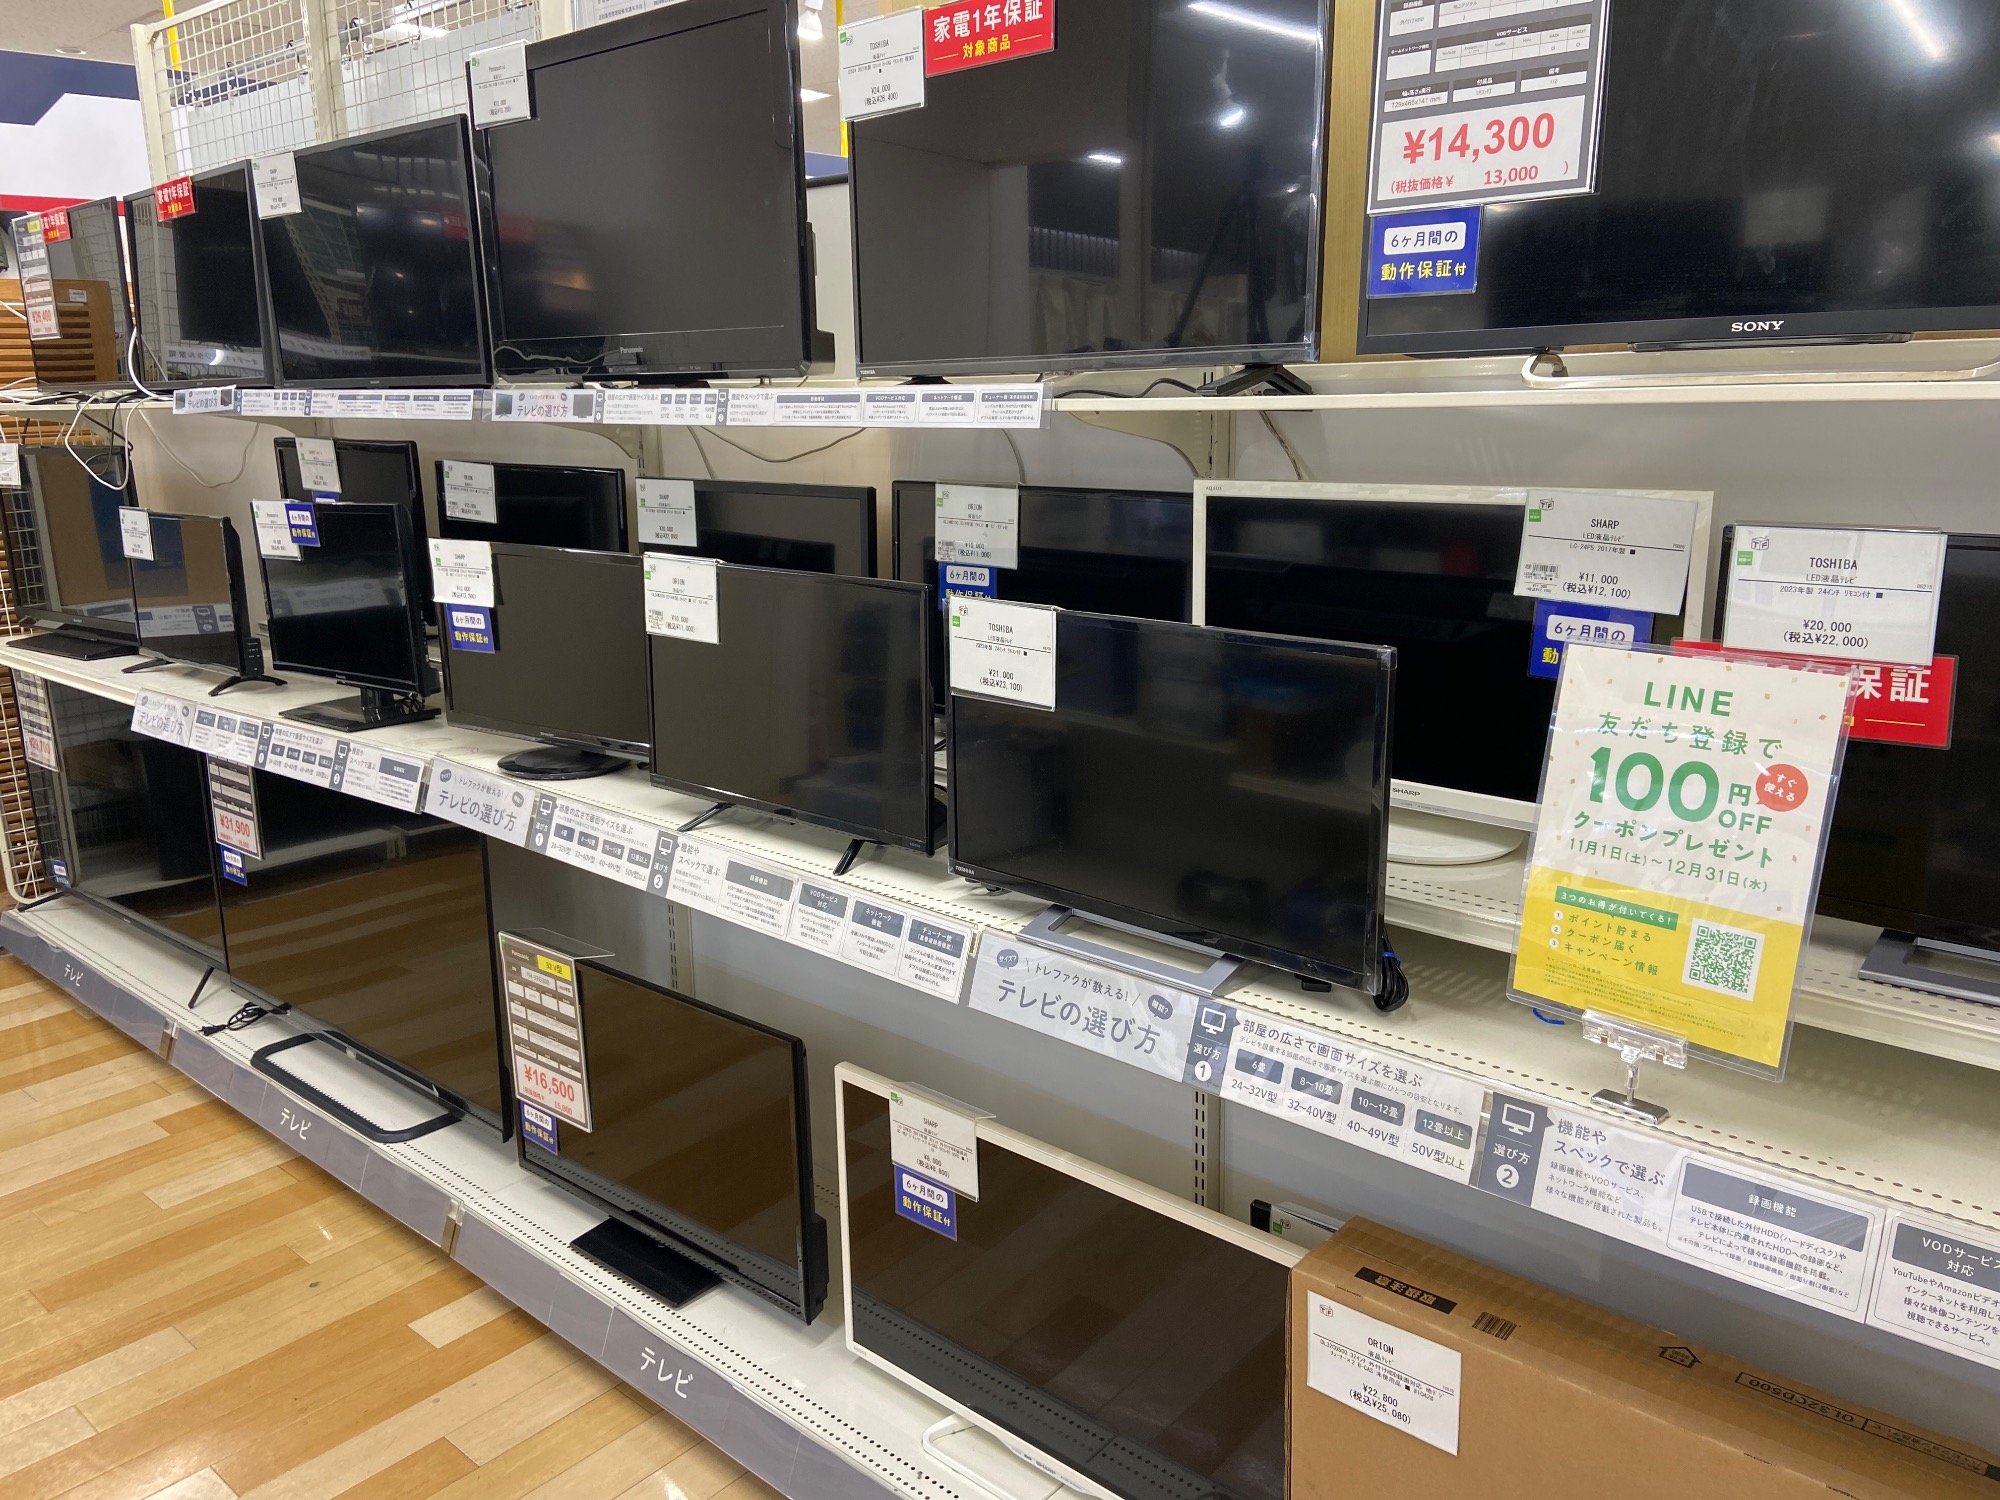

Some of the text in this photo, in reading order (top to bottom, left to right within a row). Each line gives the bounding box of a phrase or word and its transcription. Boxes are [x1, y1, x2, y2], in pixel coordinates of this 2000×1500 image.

[933, 0, 1043, 43] 家電1年保証
[1496, 26, 1528, 37] VODサービス
[870, 39, 889, 50] TOSHIBA
[963, 34, 1011, 60] 対象商品
[864, 91, 898, 106] (税込¥26,400)
[871, 84, 890, 94] ¥24,000
[1403, 112, 1555, 164] ¥14,300
[1484, 165, 1538, 185] 13,000
[1390, 229, 1459, 250] 6ヶ月間の
[1380, 259, 1467, 282] 動作保証付
[1731, 320, 1785, 333] SONY
[517, 404, 569, 418] テレビの選び方
[1590, 519, 1619, 529] SHARP
[1810, 557, 1857, 570] TOSHIBA
[672, 578, 685, 586] ORION
[950, 570, 986, 582] 6ヶ月間の
[1579, 572, 1618, 585] ¥11,000
[1563, 581, 1631, 599] (税込¥12,100)
[1780, 585, 1814, 595] 2023年製
[455, 615, 482, 626] 6ヶ月間の
[665, 621, 695, 633] (税込¥11,000)
[671, 614, 688, 624] ¥10,000
[988, 622, 1013, 635] TOSHIBA
[1803, 619, 1852, 633] ¥20,000
[454, 631, 489, 645] 動作保証付
[1783, 631, 1869, 649] (税込¥22,000)
[988, 668, 1014, 680] ¥21,000
[979, 677, 1023, 693] (税込¥23,100)
[1643, 681, 1734, 717] LINE
[1597, 712, 1783, 759] 友だち登録で
[1776, 773, 1798, 788] すぐ
[1392, 788, 1420, 796] SHARP
[1763, 781, 1795, 802] 使える
[439, 790, 518, 832] テレビの選び方
[559, 803, 634, 835] 部屋の広さで画面サイズを選ぶ
[220, 813, 250, 838] ¥31,900
[1718, 809, 1772, 835] OFF
[1573, 811, 1773, 869] クーポンプレゼント
[654, 862, 668, 874] 選び方
[677, 856, 721, 876] スペックで選ぶ
[656, 877, 662, 887] 2
[810, 890, 838, 904] VODサービス
[866, 908, 892, 922] ネットワーク
[1561, 892, 1671, 925] 3つのお得が付いてくる!
[1569, 914, 1651, 942] ポイント貯まる
[1567, 928, 1634, 953] クーポン届く
[999, 954, 1017, 963] サイズ?
[1564, 942, 1658, 975] キャンペーン情報
[63, 963, 84, 987] テレビ
[1035, 962, 1129, 1001] トレファックが教える!
[998, 979, 1161, 1055] テレビの選び方
[1192, 1042, 1222, 1061] 選び方
[1243, 1018, 1424, 1088] 部屋の広さで画面サイズを選ぶ
[1200, 1064, 1206, 1078] 1
[524, 1064, 575, 1102] ¥16,500
[554, 1101, 573, 1115] 15,000
[1251, 1061, 1266, 1075] 6畳
[1422, 1117, 1465, 1142] 12畳以上
[279, 1106, 314, 1141] テレビ
[526, 1108, 550, 1126] 6ヶ月間の
[923, 1118, 939, 1128] SHARP
[1231, 1078, 1465, 1172] 24~32V型 32~40V型 40~49V型 50V型以上
[525, 1122, 554, 1145] 動作保証付
[1557, 1119, 1607, 1145] 機能や
[924, 1154, 942, 1167] ¥8,000
[1493, 1143, 1530, 1165] 選び方
[1554, 1140, 1666, 1186] スペックで選ぶ
[917, 1158, 950, 1179] (税込¥8,800)
[1502, 1168, 1512, 1184] 2
[1547, 1174, 1622, 1205] ネットワーク機能など
[1550, 1160, 1646, 1200] 録画機能やVODサービス、
[906, 1180, 944, 1203] 6ヶ月間の
[902, 1196, 951, 1227] 動作保証付
[1545, 1186, 1664, 1232] 様々な機能が搭載された製品も。
[1748, 1194, 1797, 1218] 録画機能
[1690, 1217, 1844, 1274] テレビ本体に内蔵されたHDDへの録画など、
[1698, 1231, 1832, 1282] テレビによって様々な録画機能を搭載。
[1946, 1260, 1974, 1277] 対応
[1904, 1297, 2000, 1335] 様々な映像コンテンツを
[1907, 1311, 1990, 1346] 視聴できるサービス。
[1367, 1337, 1394, 1355] ORION
[638, 1346, 694, 1400] テレビ
[1377, 1370, 1401, 1387] 未使用品
[1363, 1383, 1398, 1407] ¥22,800
[1749, 1378, 1855, 1424] OL32CD500
[1350, 1389, 1411, 1424] (税込¥25,080)
